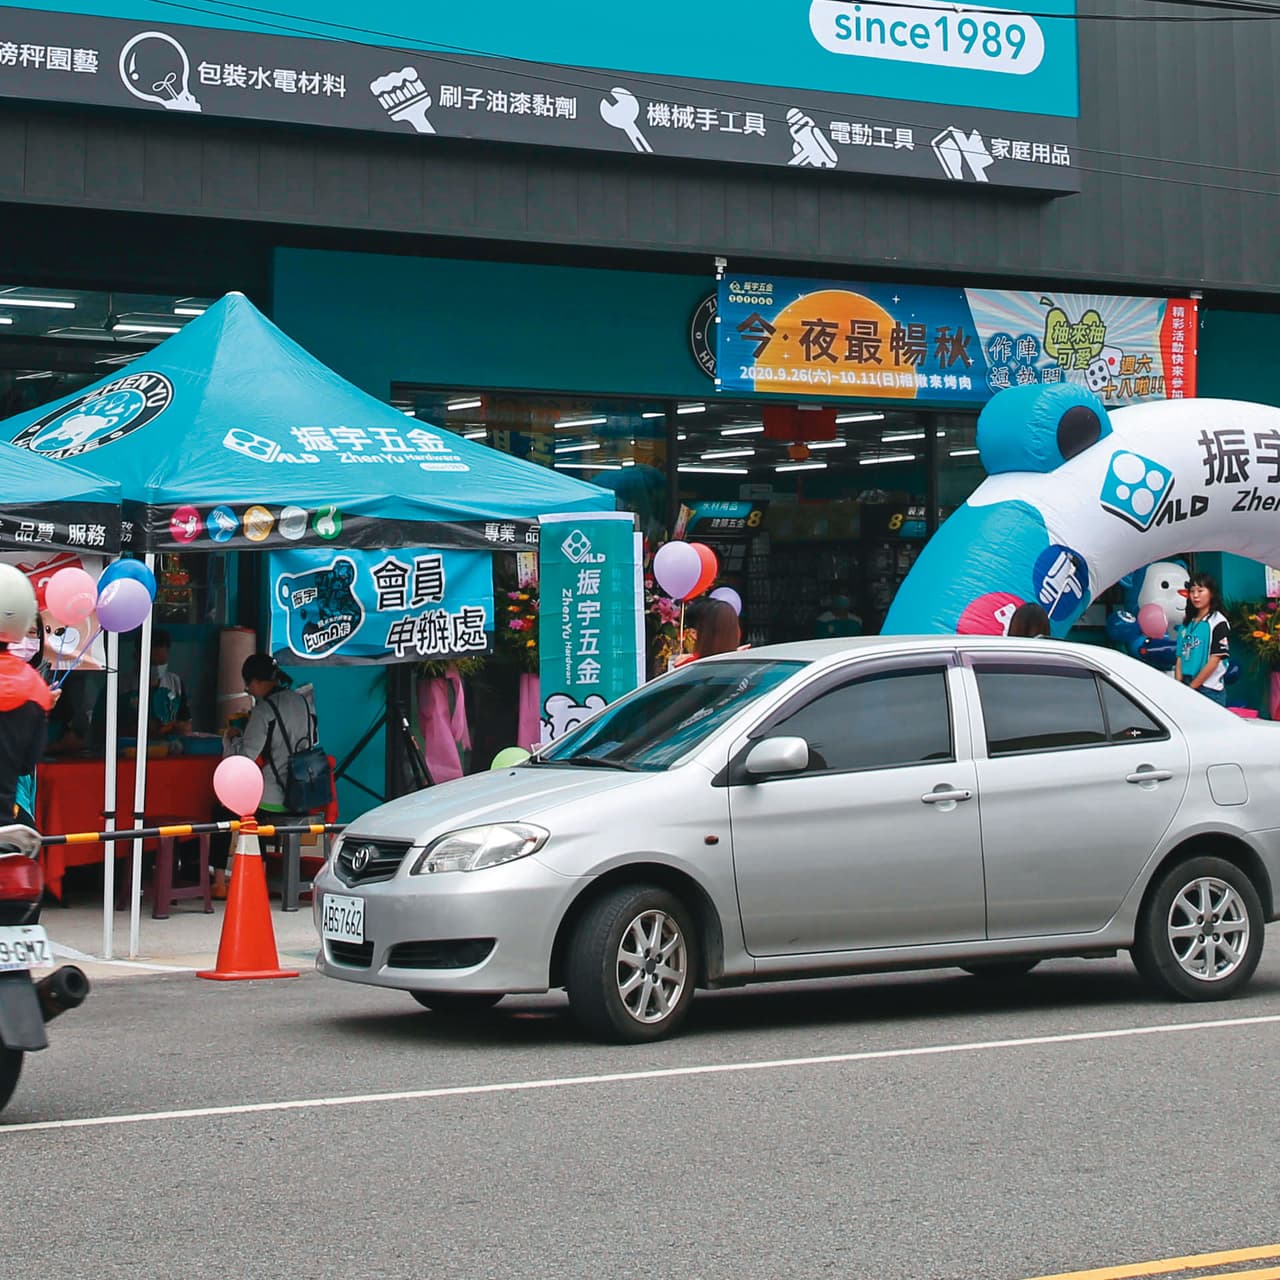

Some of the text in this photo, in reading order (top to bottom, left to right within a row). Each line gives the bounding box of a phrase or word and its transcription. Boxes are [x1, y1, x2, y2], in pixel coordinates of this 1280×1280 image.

[197, 59, 347, 100] 包裝水電材料
[439, 83, 578, 120] 刷子油漆黏劑
[647, 102, 767, 137] 機械手工具
[829, 121, 916, 152] 電動工具
[991, 137, 1071, 167] 家庭用品
[147, 382, 168, 408] YU
[290, 426, 453, 453] 振宇五金
[15, 522, 55, 543] 品質
[67, 524, 107, 546] 服務
[485, 523, 516, 543] 專業
[372, 557, 444, 610] 會員
[387, 608, 486, 656] 申辦處
[576, 569, 601, 684] 振宇五金
